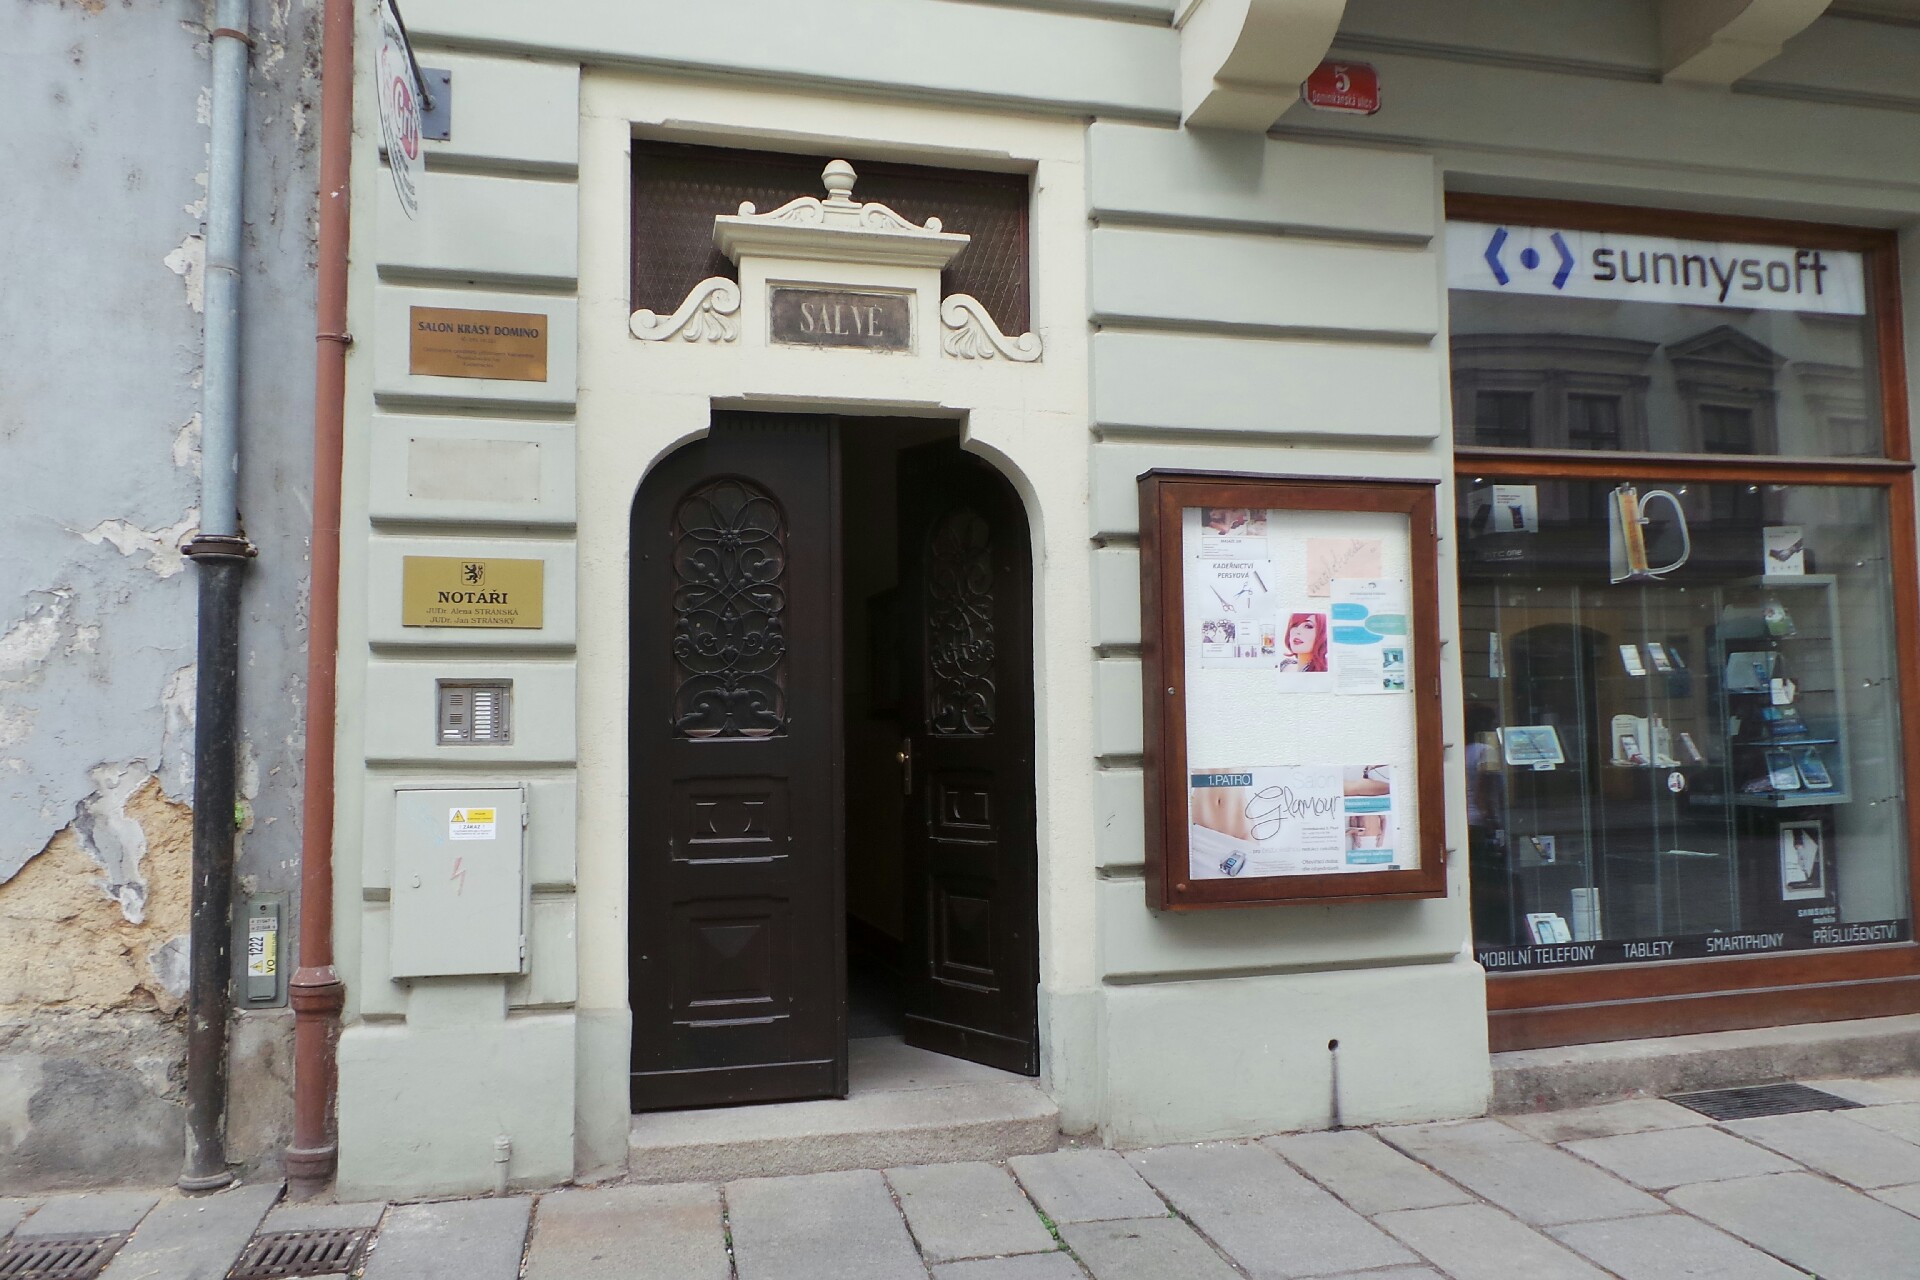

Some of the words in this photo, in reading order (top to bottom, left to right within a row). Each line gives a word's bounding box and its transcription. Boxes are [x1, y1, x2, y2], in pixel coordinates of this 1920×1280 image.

[1335, 65, 1350, 93] 5
[1592, 248, 1827, 303] sunnysoft
[418, 322, 454, 333] SALON
[494, 326, 539, 338] DOMINO
[800, 303, 883, 337] SALVE
[438, 589, 508, 605] NOTÁŘI
[1244, 786, 1341, 840] Glamour
[1798, 907, 1836, 917] SAMSUNG
[1706, 932, 1784, 952] SMARTPHONY
[1813, 921, 1897, 944] PŘÍSLUŠENSTVÍ
[249, 936, 264, 956] 1222
[1479, 946, 1531, 967] MOBILNÍ
[1535, 945, 1596, 964] TELEFONY
[1622, 941, 1674, 958] TABLETY
